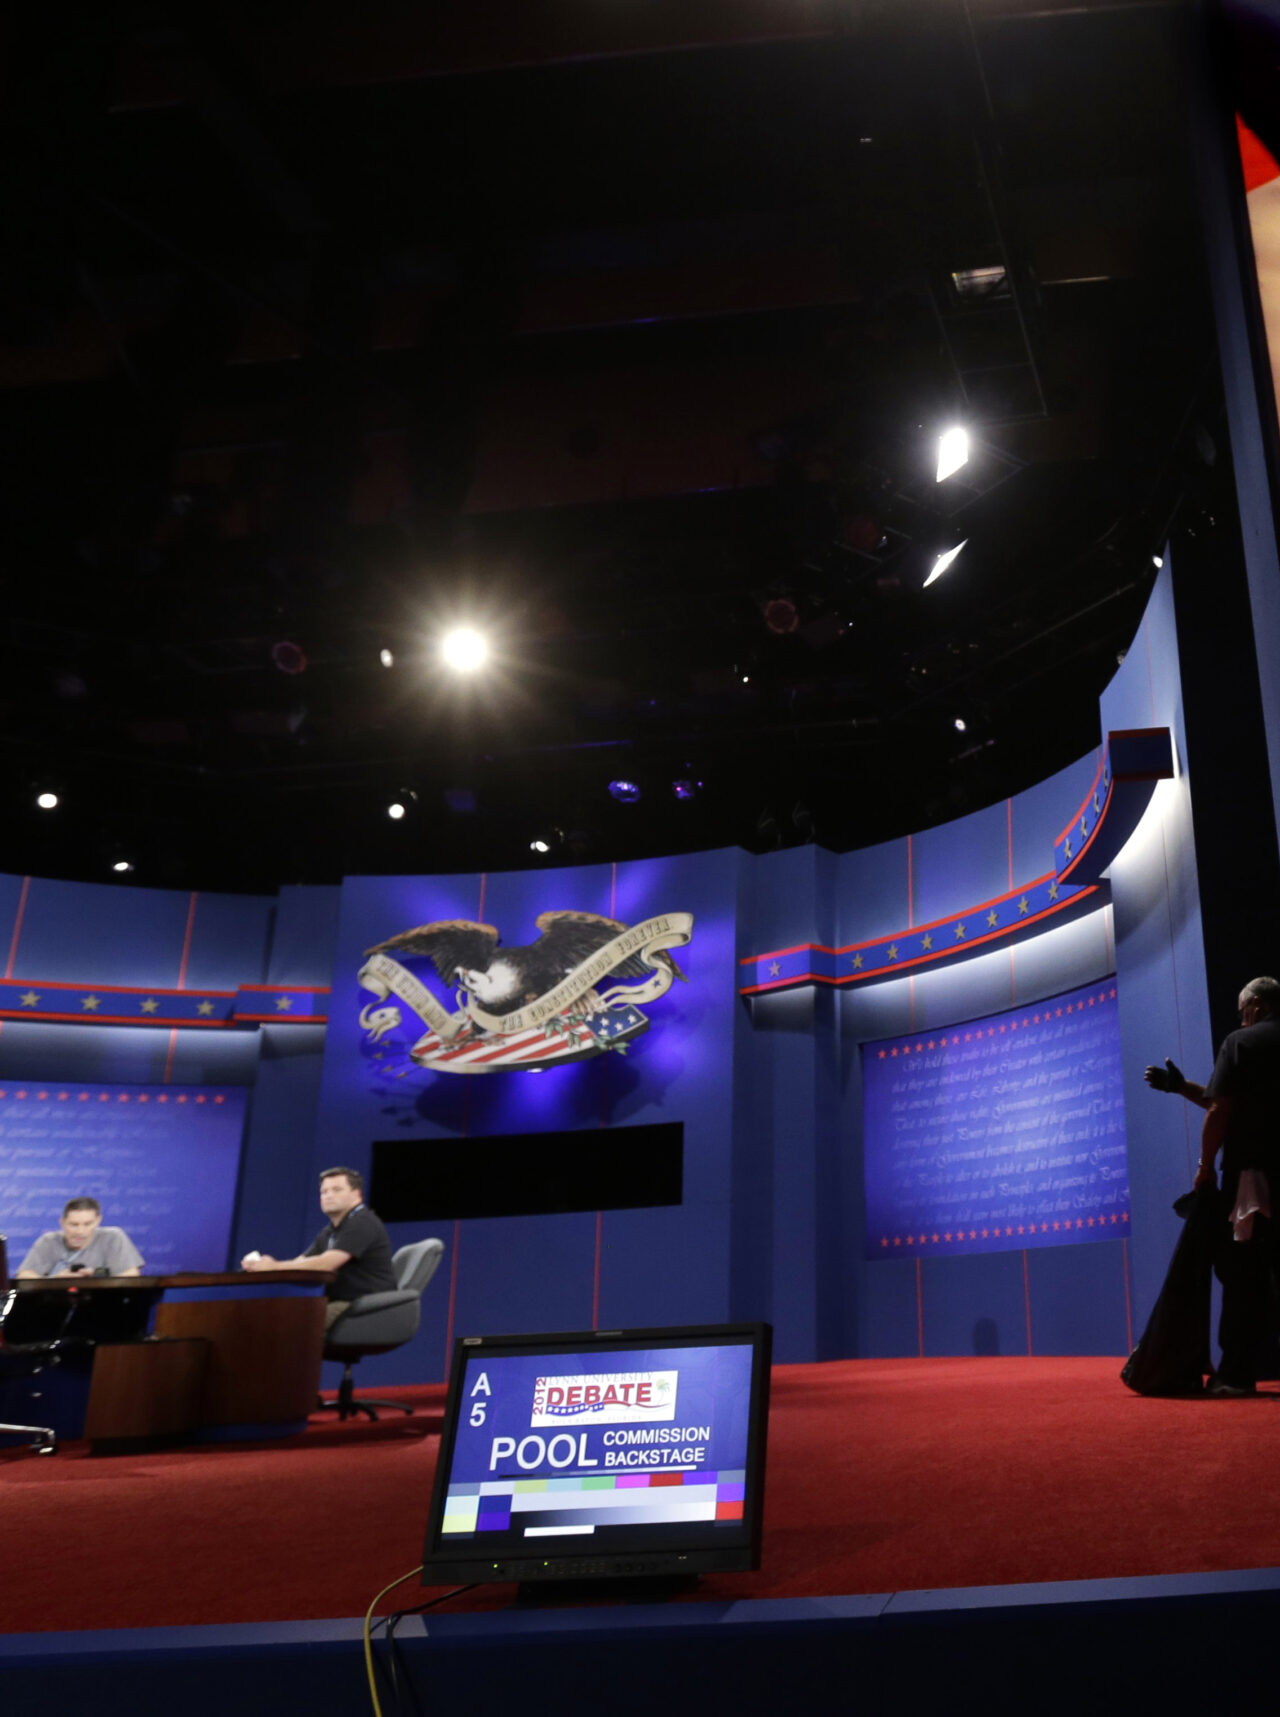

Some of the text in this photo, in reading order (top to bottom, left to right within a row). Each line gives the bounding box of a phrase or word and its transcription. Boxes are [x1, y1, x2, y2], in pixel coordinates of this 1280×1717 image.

[615, 918, 671, 954] FOREVER
[470, 1372, 492, 1398] A
[532, 1376, 547, 1416] 2012
[547, 1382, 653, 1407] DEBATE
[469, 1402, 487, 1428] 5
[603, 1426, 711, 1447] COMMISSION
[489, 1433, 599, 1471] POOL
[604, 1447, 706, 1467] BACKSTAGE
